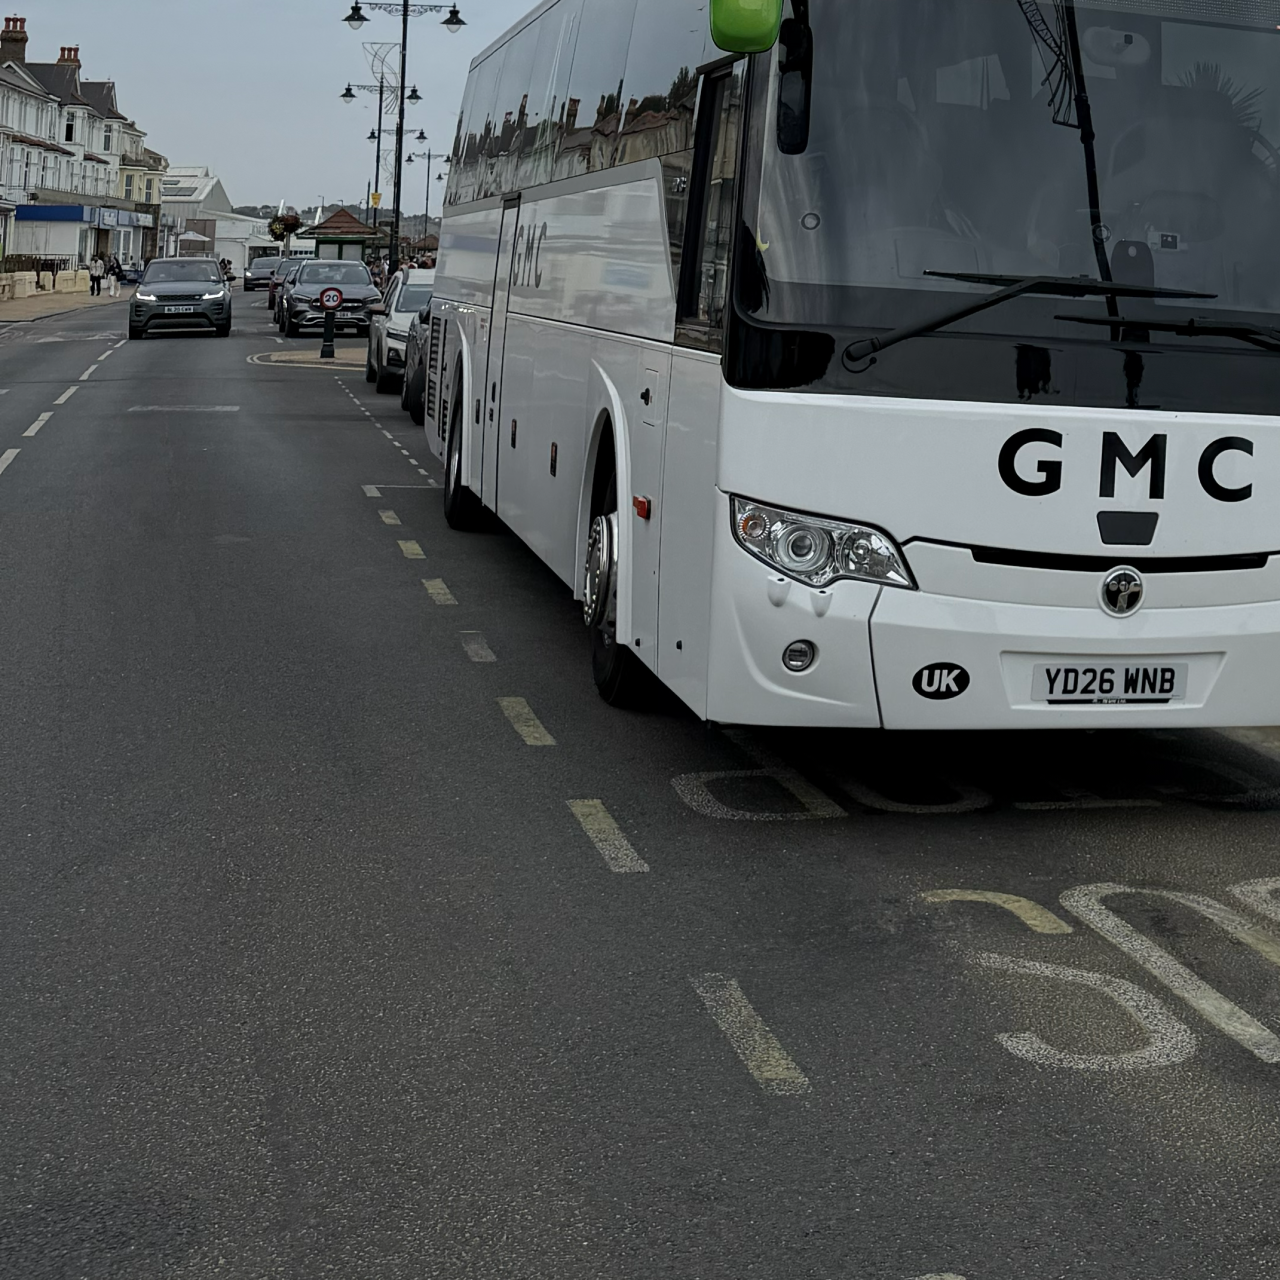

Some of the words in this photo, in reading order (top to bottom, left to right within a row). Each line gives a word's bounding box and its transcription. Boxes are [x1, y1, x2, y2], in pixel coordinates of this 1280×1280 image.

[513, 222, 547, 288] GMC
[325, 294, 339, 302] 20
[921, 669, 961, 692] UK
[1045, 667, 1115, 695] YD26
[1124, 667, 1175, 694] WNB
